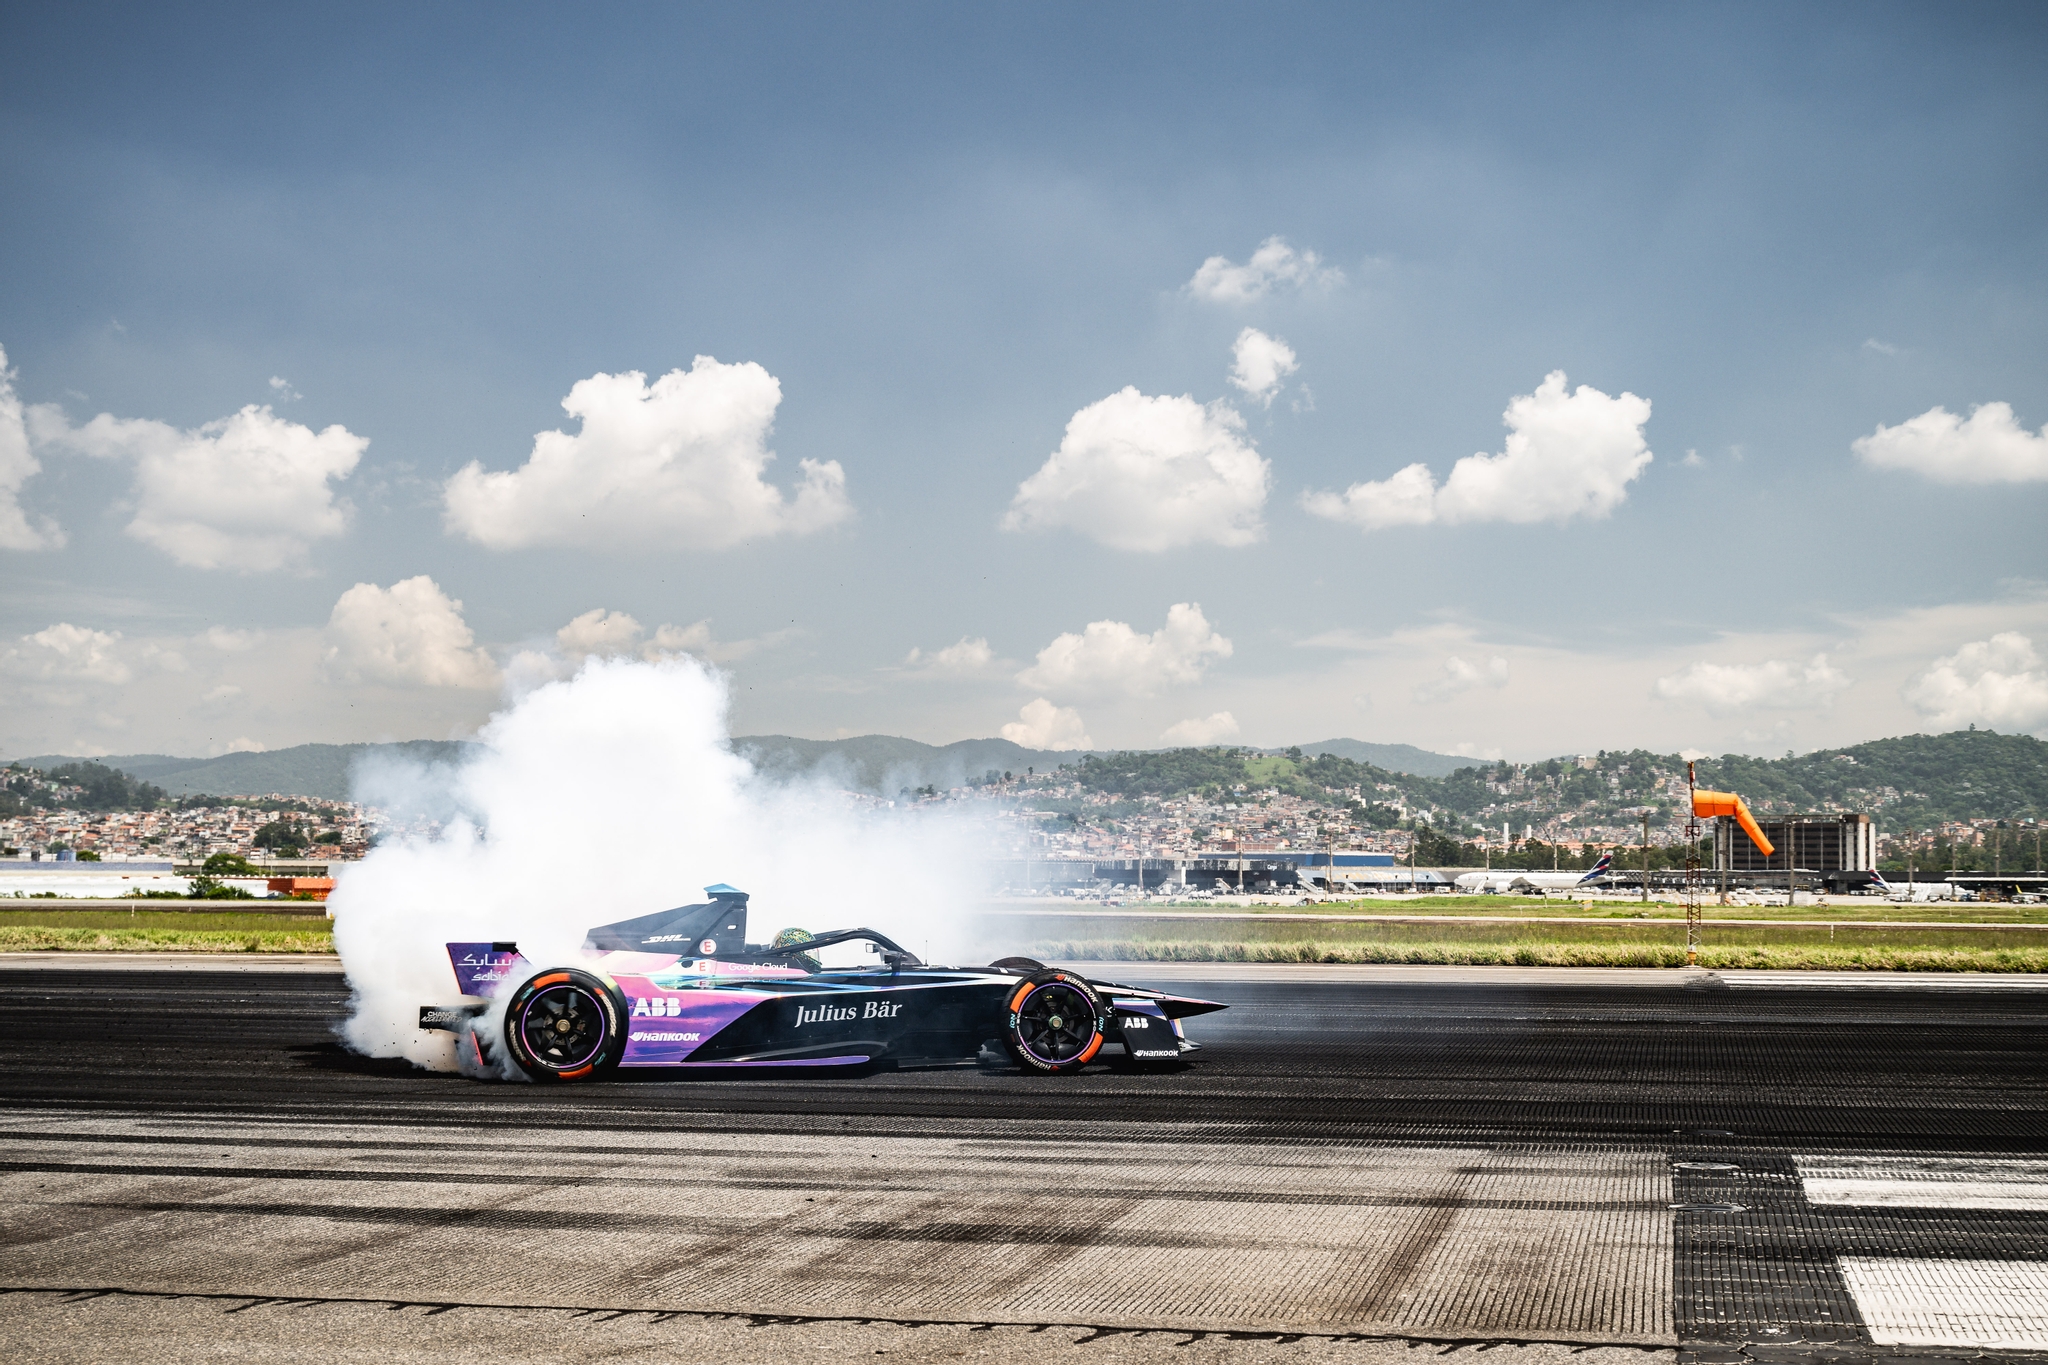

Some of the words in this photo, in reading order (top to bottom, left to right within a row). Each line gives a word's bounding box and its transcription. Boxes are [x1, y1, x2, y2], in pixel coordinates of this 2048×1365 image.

[645, 934, 689, 943] DHL
[704, 941, 712, 952] E
[456, 953, 512, 970] سابك
[728, 962, 762, 974] Google
[762, 962, 788, 971] Cloud
[632, 997, 682, 1017] ABB
[794, 1004, 857, 1028] Julius
[862, 1001, 903, 1019] Bär
[1124, 1017, 1149, 1029] ABB
